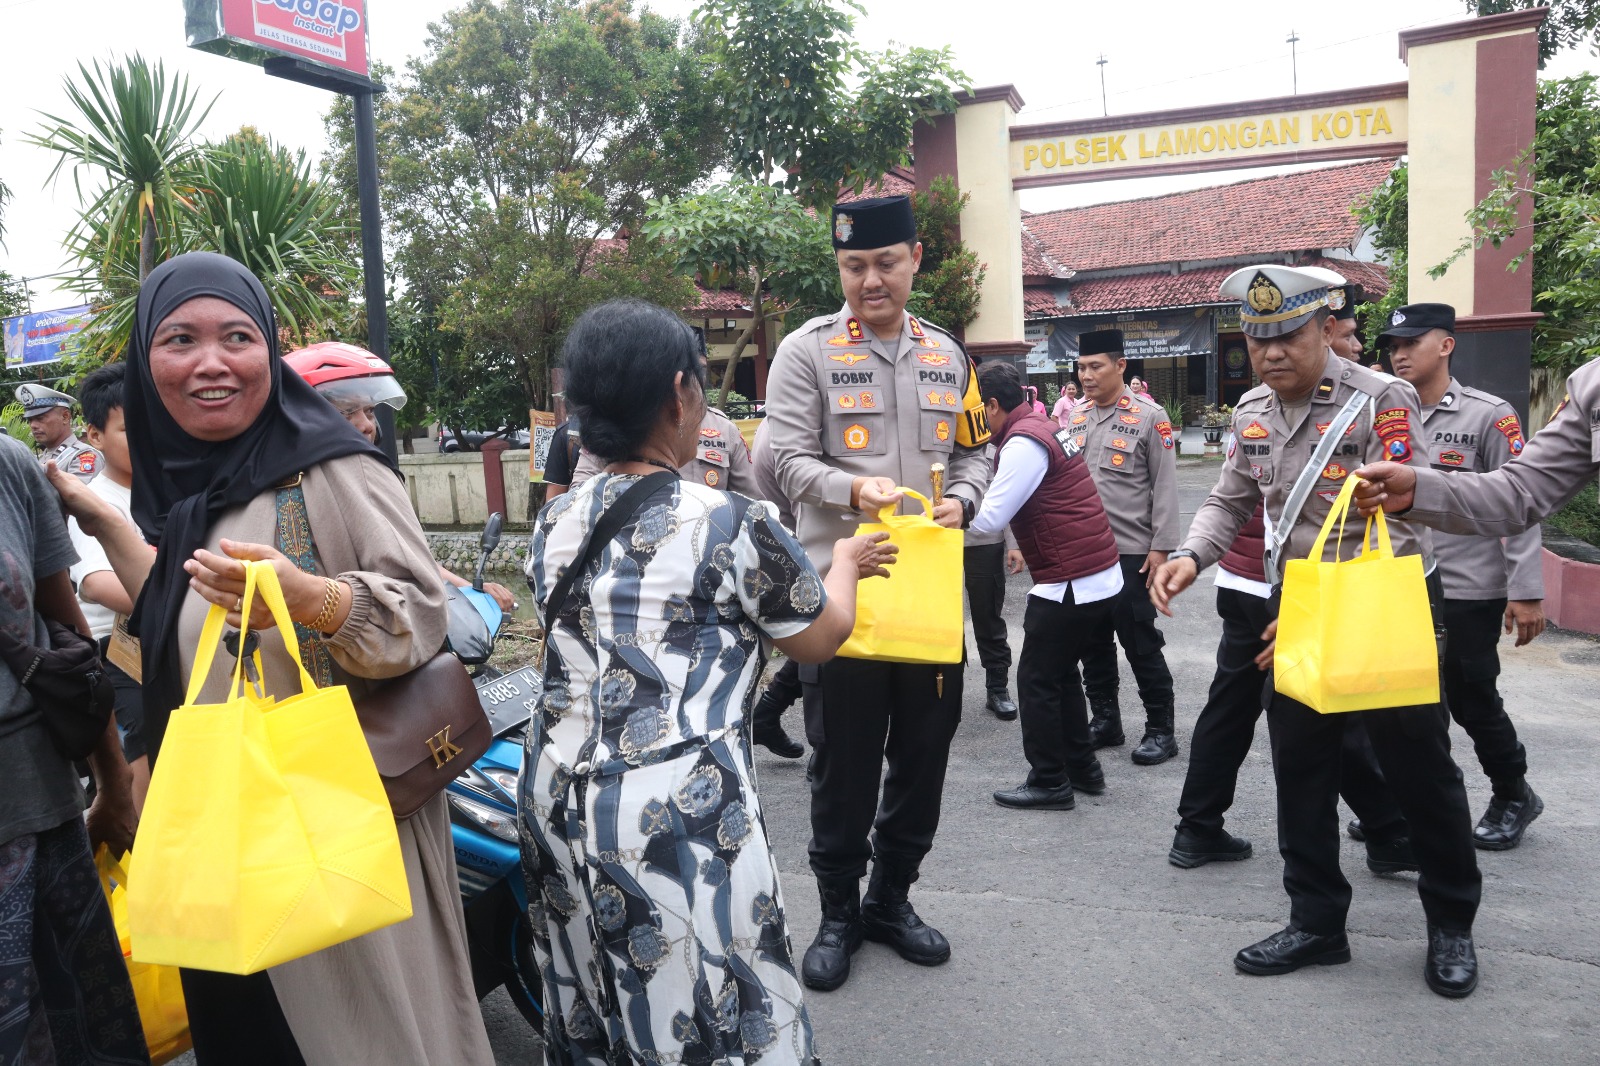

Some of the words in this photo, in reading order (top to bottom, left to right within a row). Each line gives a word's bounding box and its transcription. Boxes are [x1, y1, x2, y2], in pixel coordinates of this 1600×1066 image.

[259, 28, 280, 40] JELAS
[282, 34, 308, 48] TERASA
[309, 43, 342, 58] SEDAPNYA
[1023, 134, 1127, 170] POLSEK
[1138, 116, 1300, 160] LAMONGAN
[1311, 106, 1393, 142] KOTA
[1115, 320, 1159, 331] INTEGRITAS
[832, 372, 873, 384] BOBBY
[919, 370, 957, 385] POLRI
[1111, 424, 1140, 436] POLRI
[698, 440, 726, 448] POLRI
[1435, 432, 1474, 445] POLRI
[482, 680, 520, 706] 3885
